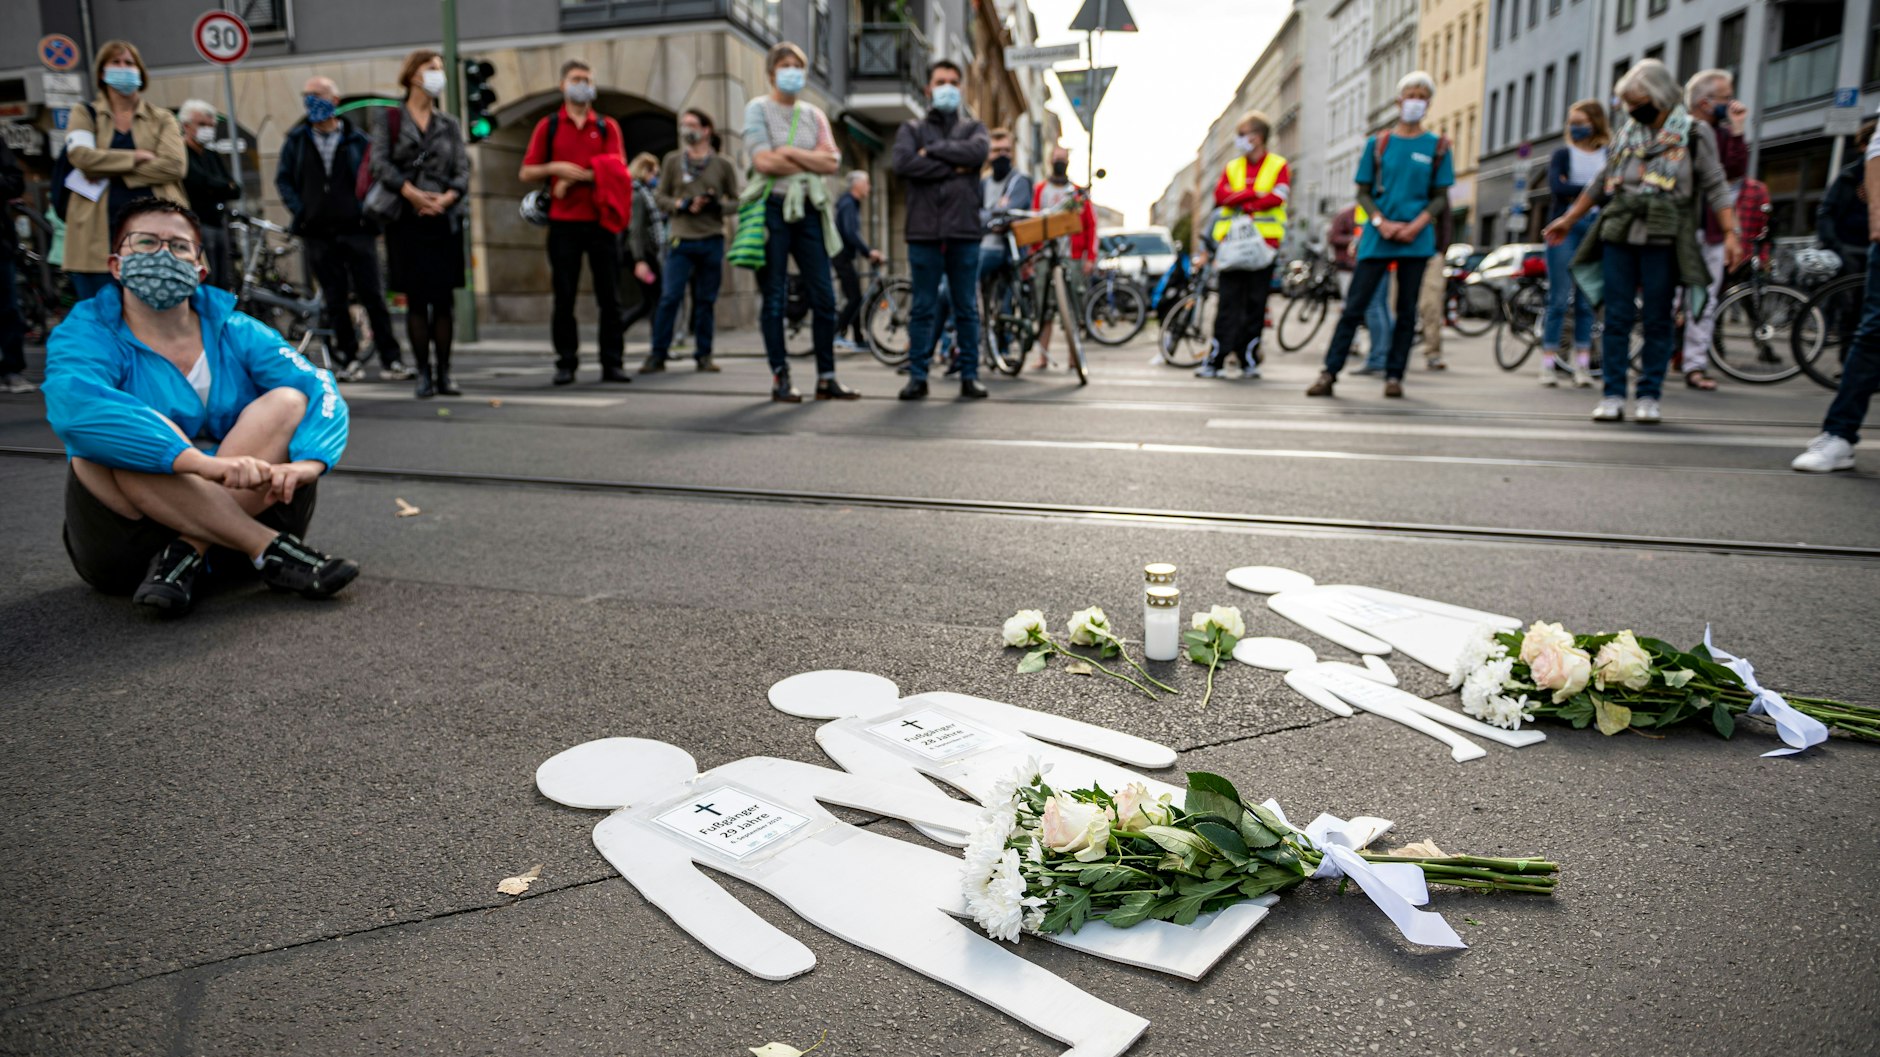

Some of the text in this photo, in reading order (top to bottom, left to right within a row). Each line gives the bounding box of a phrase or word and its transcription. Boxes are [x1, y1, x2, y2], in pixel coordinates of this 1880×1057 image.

[207, 25, 238, 50] 30
[904, 723, 956, 742] Fußgänger
[936, 730, 964, 741] Jahre
[699, 804, 760, 835] Fußgänger
[720, 828, 738, 839] 29
[738, 813, 770, 831] Jahre
